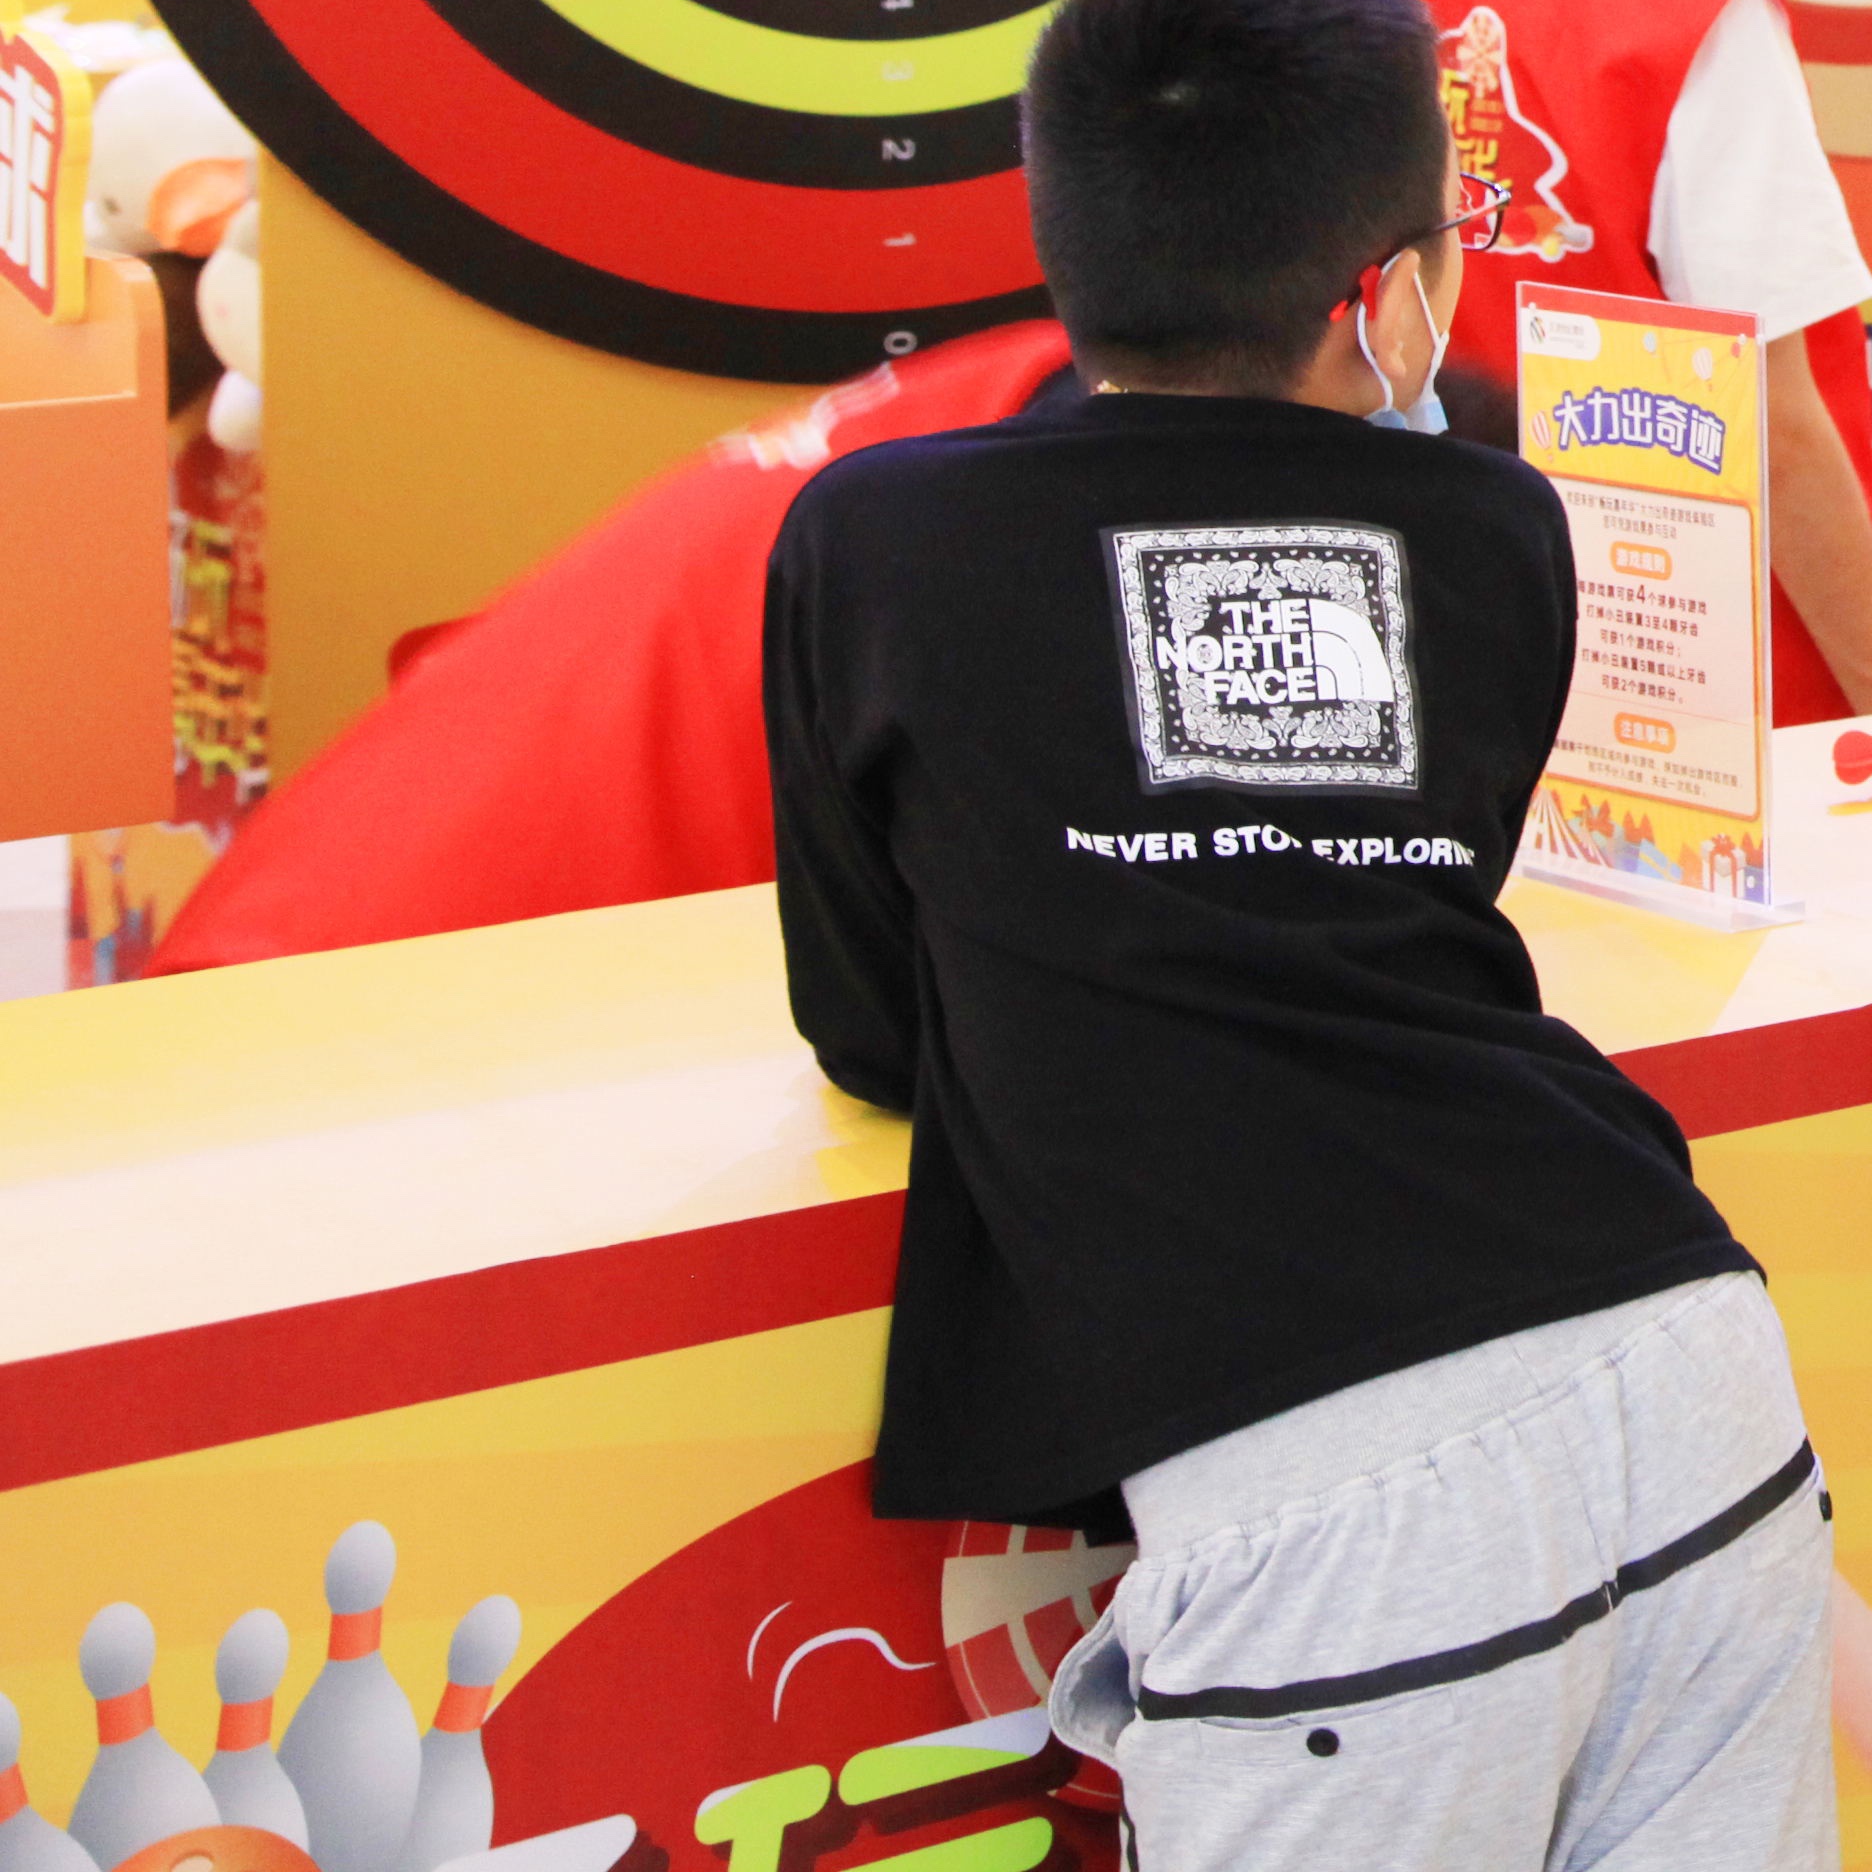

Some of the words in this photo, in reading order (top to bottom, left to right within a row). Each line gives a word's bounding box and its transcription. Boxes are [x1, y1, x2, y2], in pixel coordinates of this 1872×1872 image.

[882, 139, 916, 161] 2
[884, 233, 916, 247] 1
[883, 330, 917, 356] 0
[1554, 390, 1724, 473] 大力出奇迹
[1219, 598, 1310, 635] THE
[1155, 632, 1315, 672] NORTH
[1203, 667, 1317, 705] FACE
[1066, 826, 1199, 863] NEVER
[1212, 823, 1303, 857] STO
